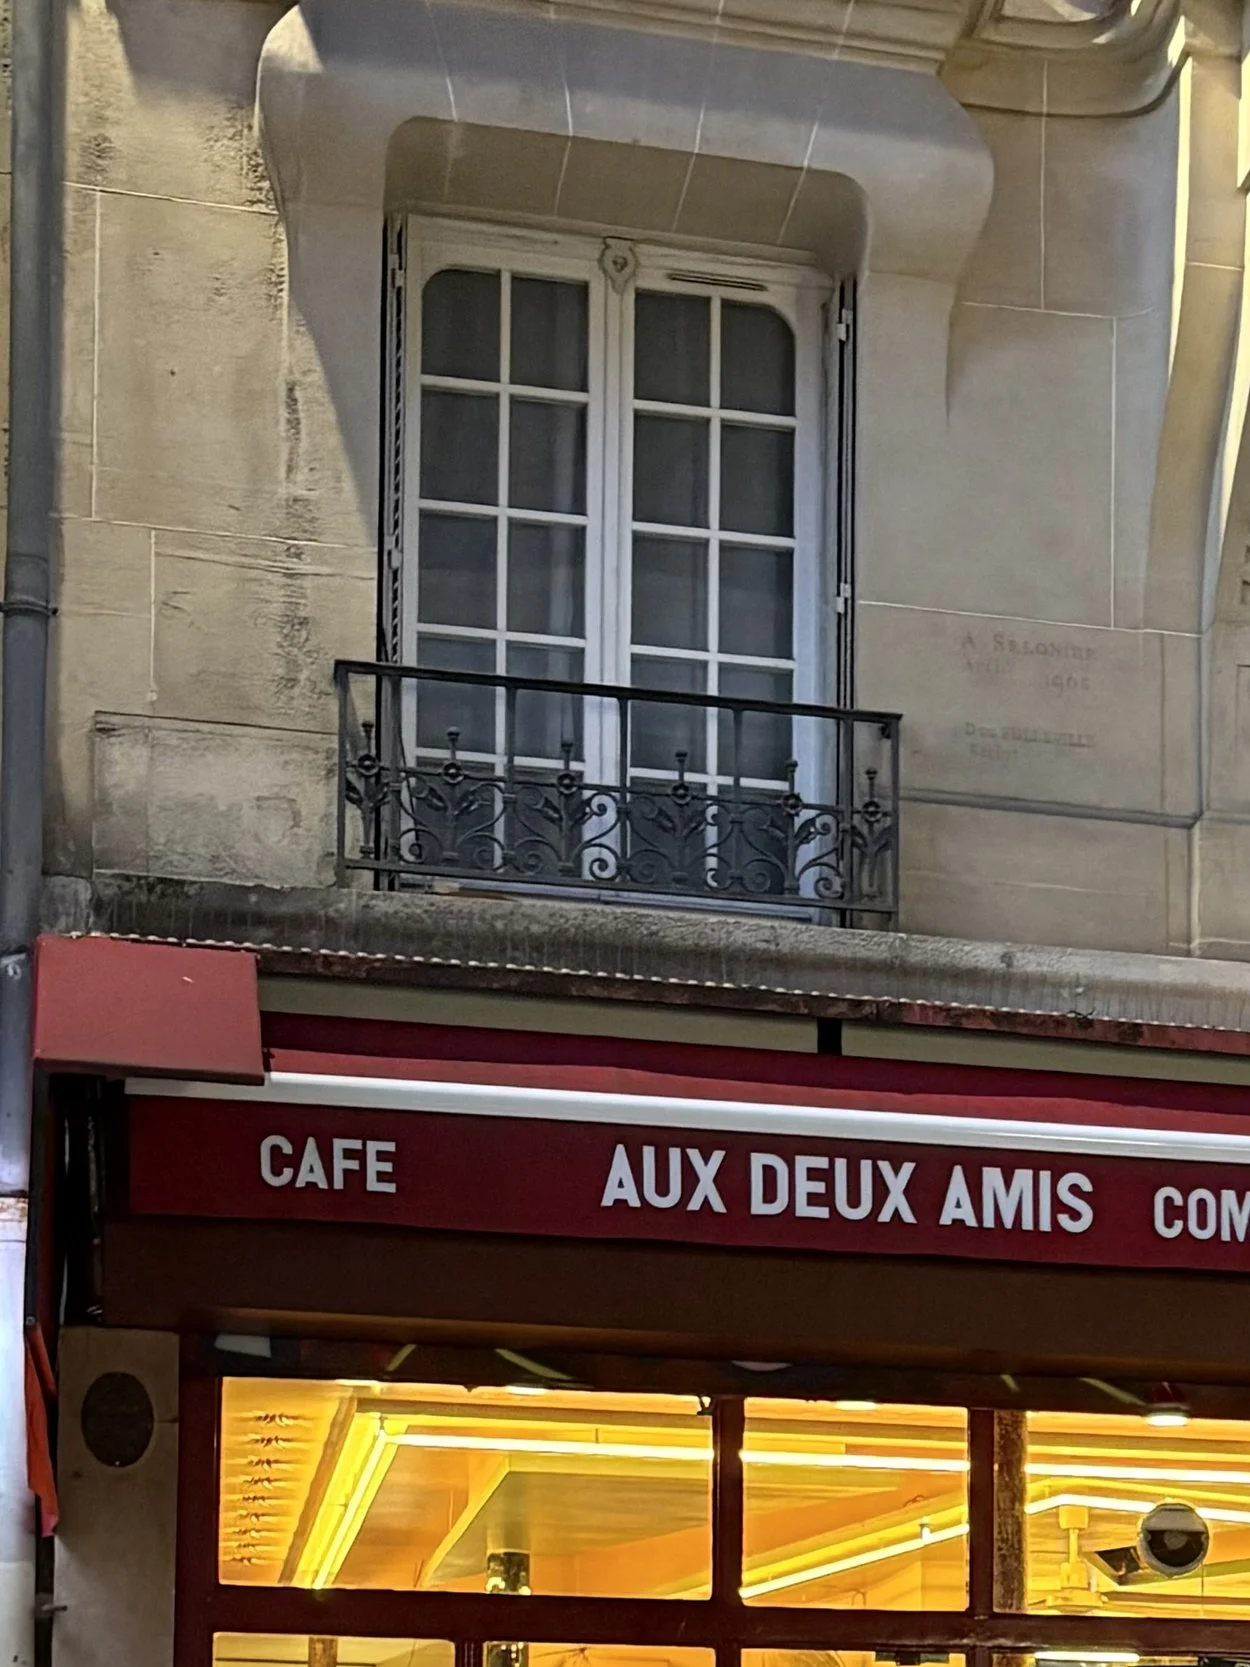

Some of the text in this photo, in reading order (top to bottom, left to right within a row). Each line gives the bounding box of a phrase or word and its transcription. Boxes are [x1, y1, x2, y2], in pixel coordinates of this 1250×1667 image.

[261, 1135, 396, 1193] CAFE
[601, 1143, 1094, 1233] AUX DEUX AMIS
